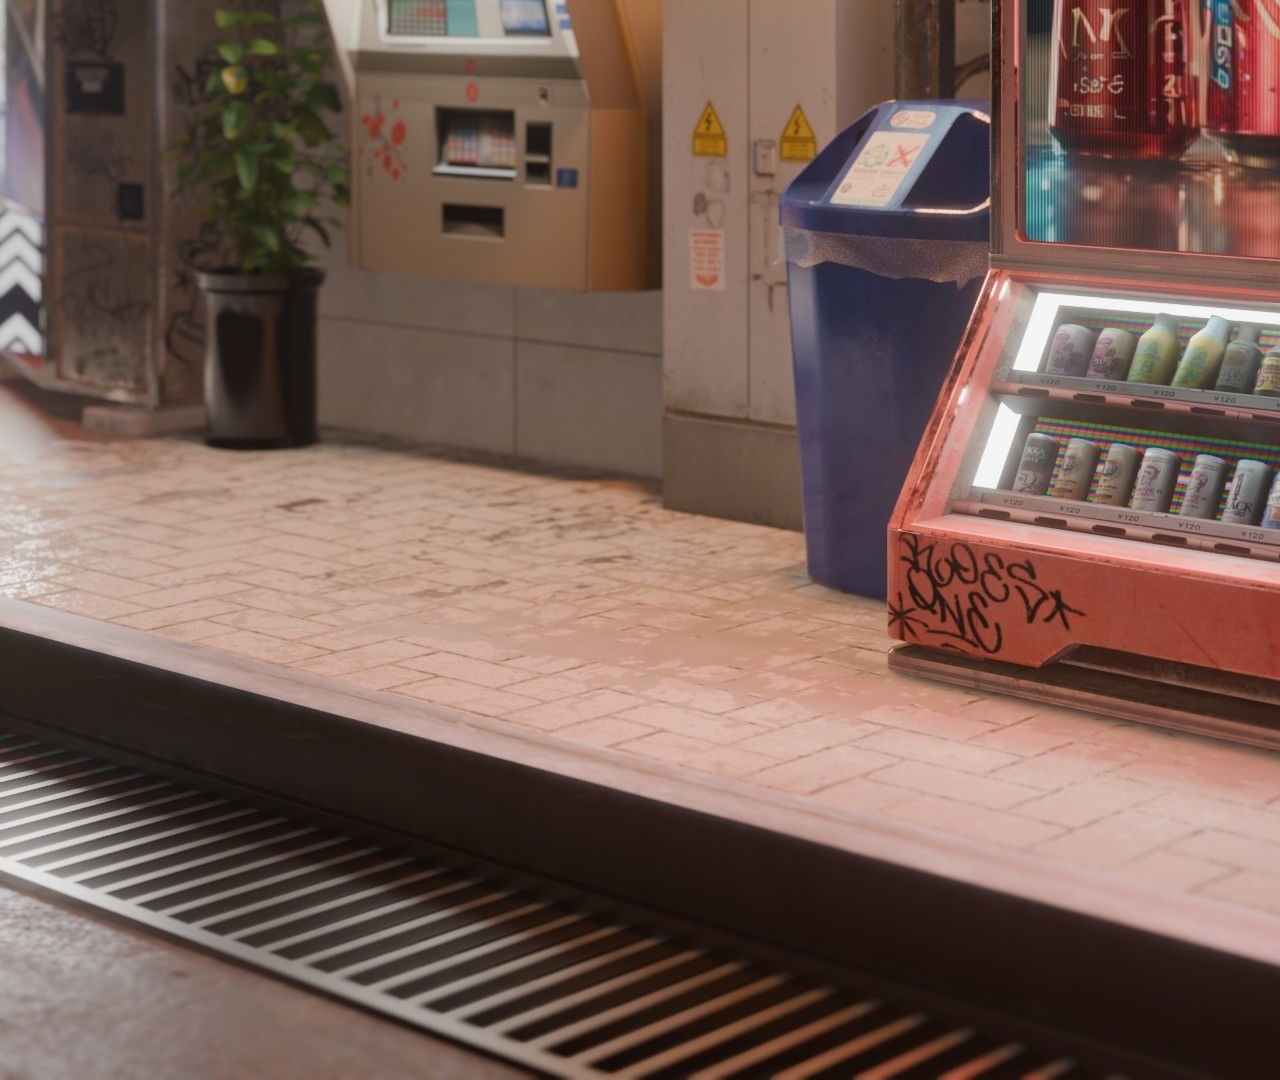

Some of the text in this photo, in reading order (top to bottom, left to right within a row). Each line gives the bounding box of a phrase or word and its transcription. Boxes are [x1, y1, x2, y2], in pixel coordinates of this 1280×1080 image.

[1096, 384, 1117, 392] ¥120
[1154, 390, 1176, 398] ¥120
[1214, 396, 1236, 404] ¥120
[1004, 498, 1024, 506] ¥120
[1060, 506, 1080, 514] ¥120
[1118, 514, 1140, 522] ¥120
[1178, 522, 1200, 531] ¥120
[1241, 530, 1264, 540] ¥120
